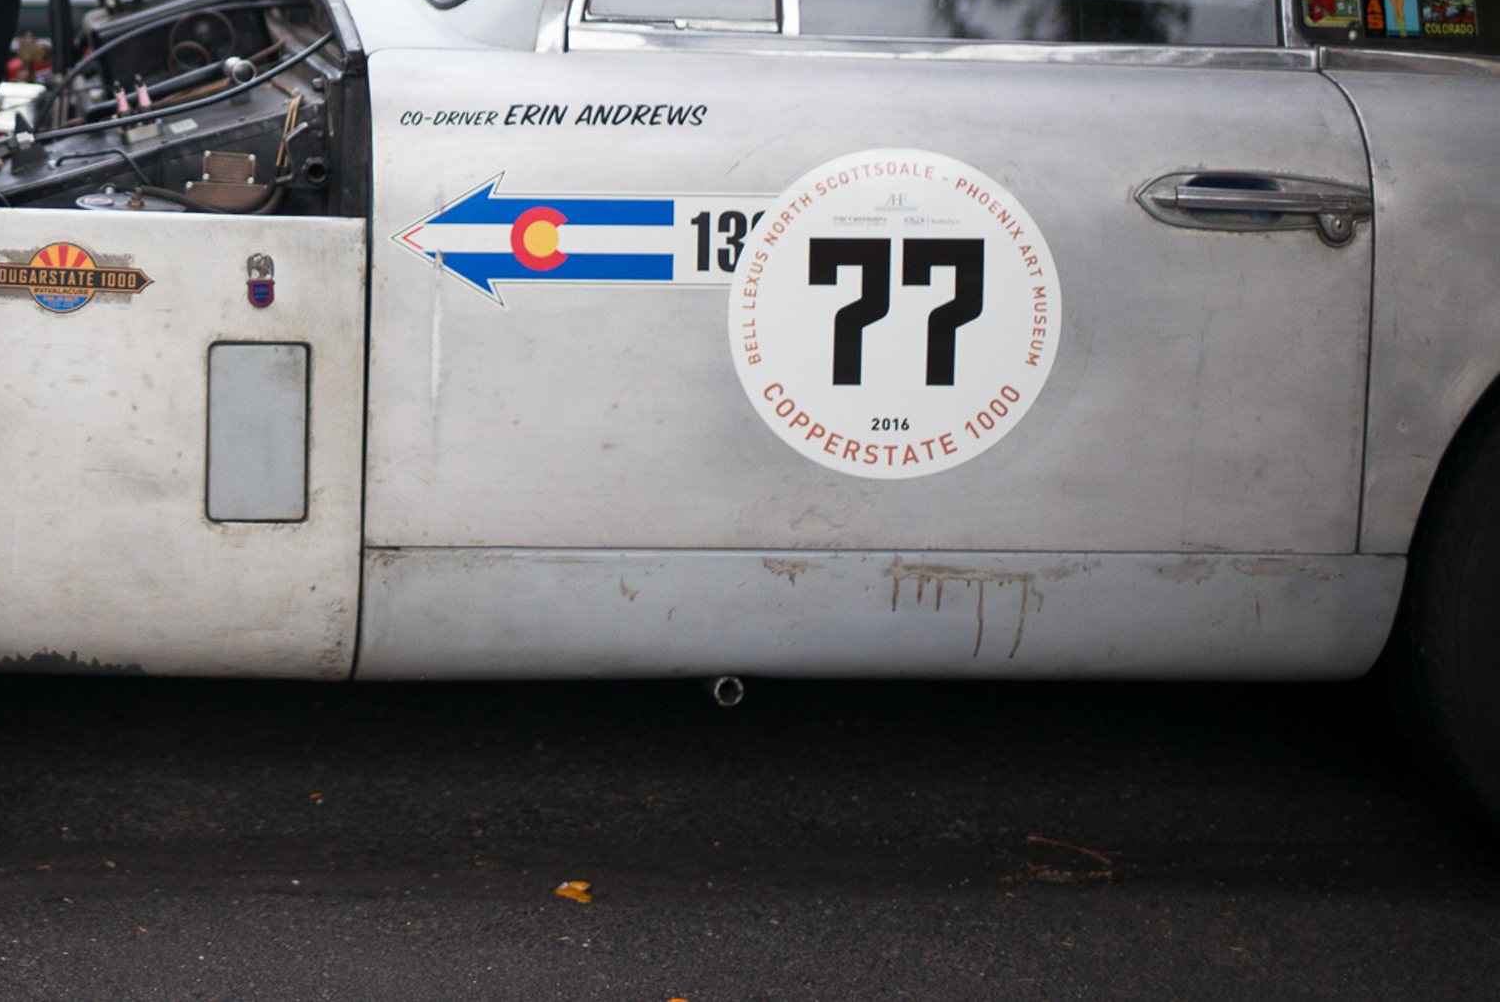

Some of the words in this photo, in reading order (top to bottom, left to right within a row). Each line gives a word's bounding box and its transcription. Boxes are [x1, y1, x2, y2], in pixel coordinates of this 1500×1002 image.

[1424, 22, 1475, 35] COLORADO
[400, 109, 498, 127] CO-DRIVER
[503, 104, 568, 127] ERIN
[575, 104, 709, 127] ANDREWS
[814, 161, 936, 197] SCOTTSDALE
[763, 192, 813, 247] NORTH
[954, 177, 1025, 241] PHOENIX
[690, 210, 767, 272] 13
[1018, 243, 1044, 279] ART
[101, 272, 137, 288] 1000
[742, 251, 769, 311] LEXUS
[808, 237, 985, 386] 77
[1024, 285, 1049, 368] MUSEUM
[742, 318, 762, 366] BELL
[763, 382, 959, 467] COPPERSTATE
[963, 384, 1022, 440] 1000
[871, 417, 910, 432] 2016
